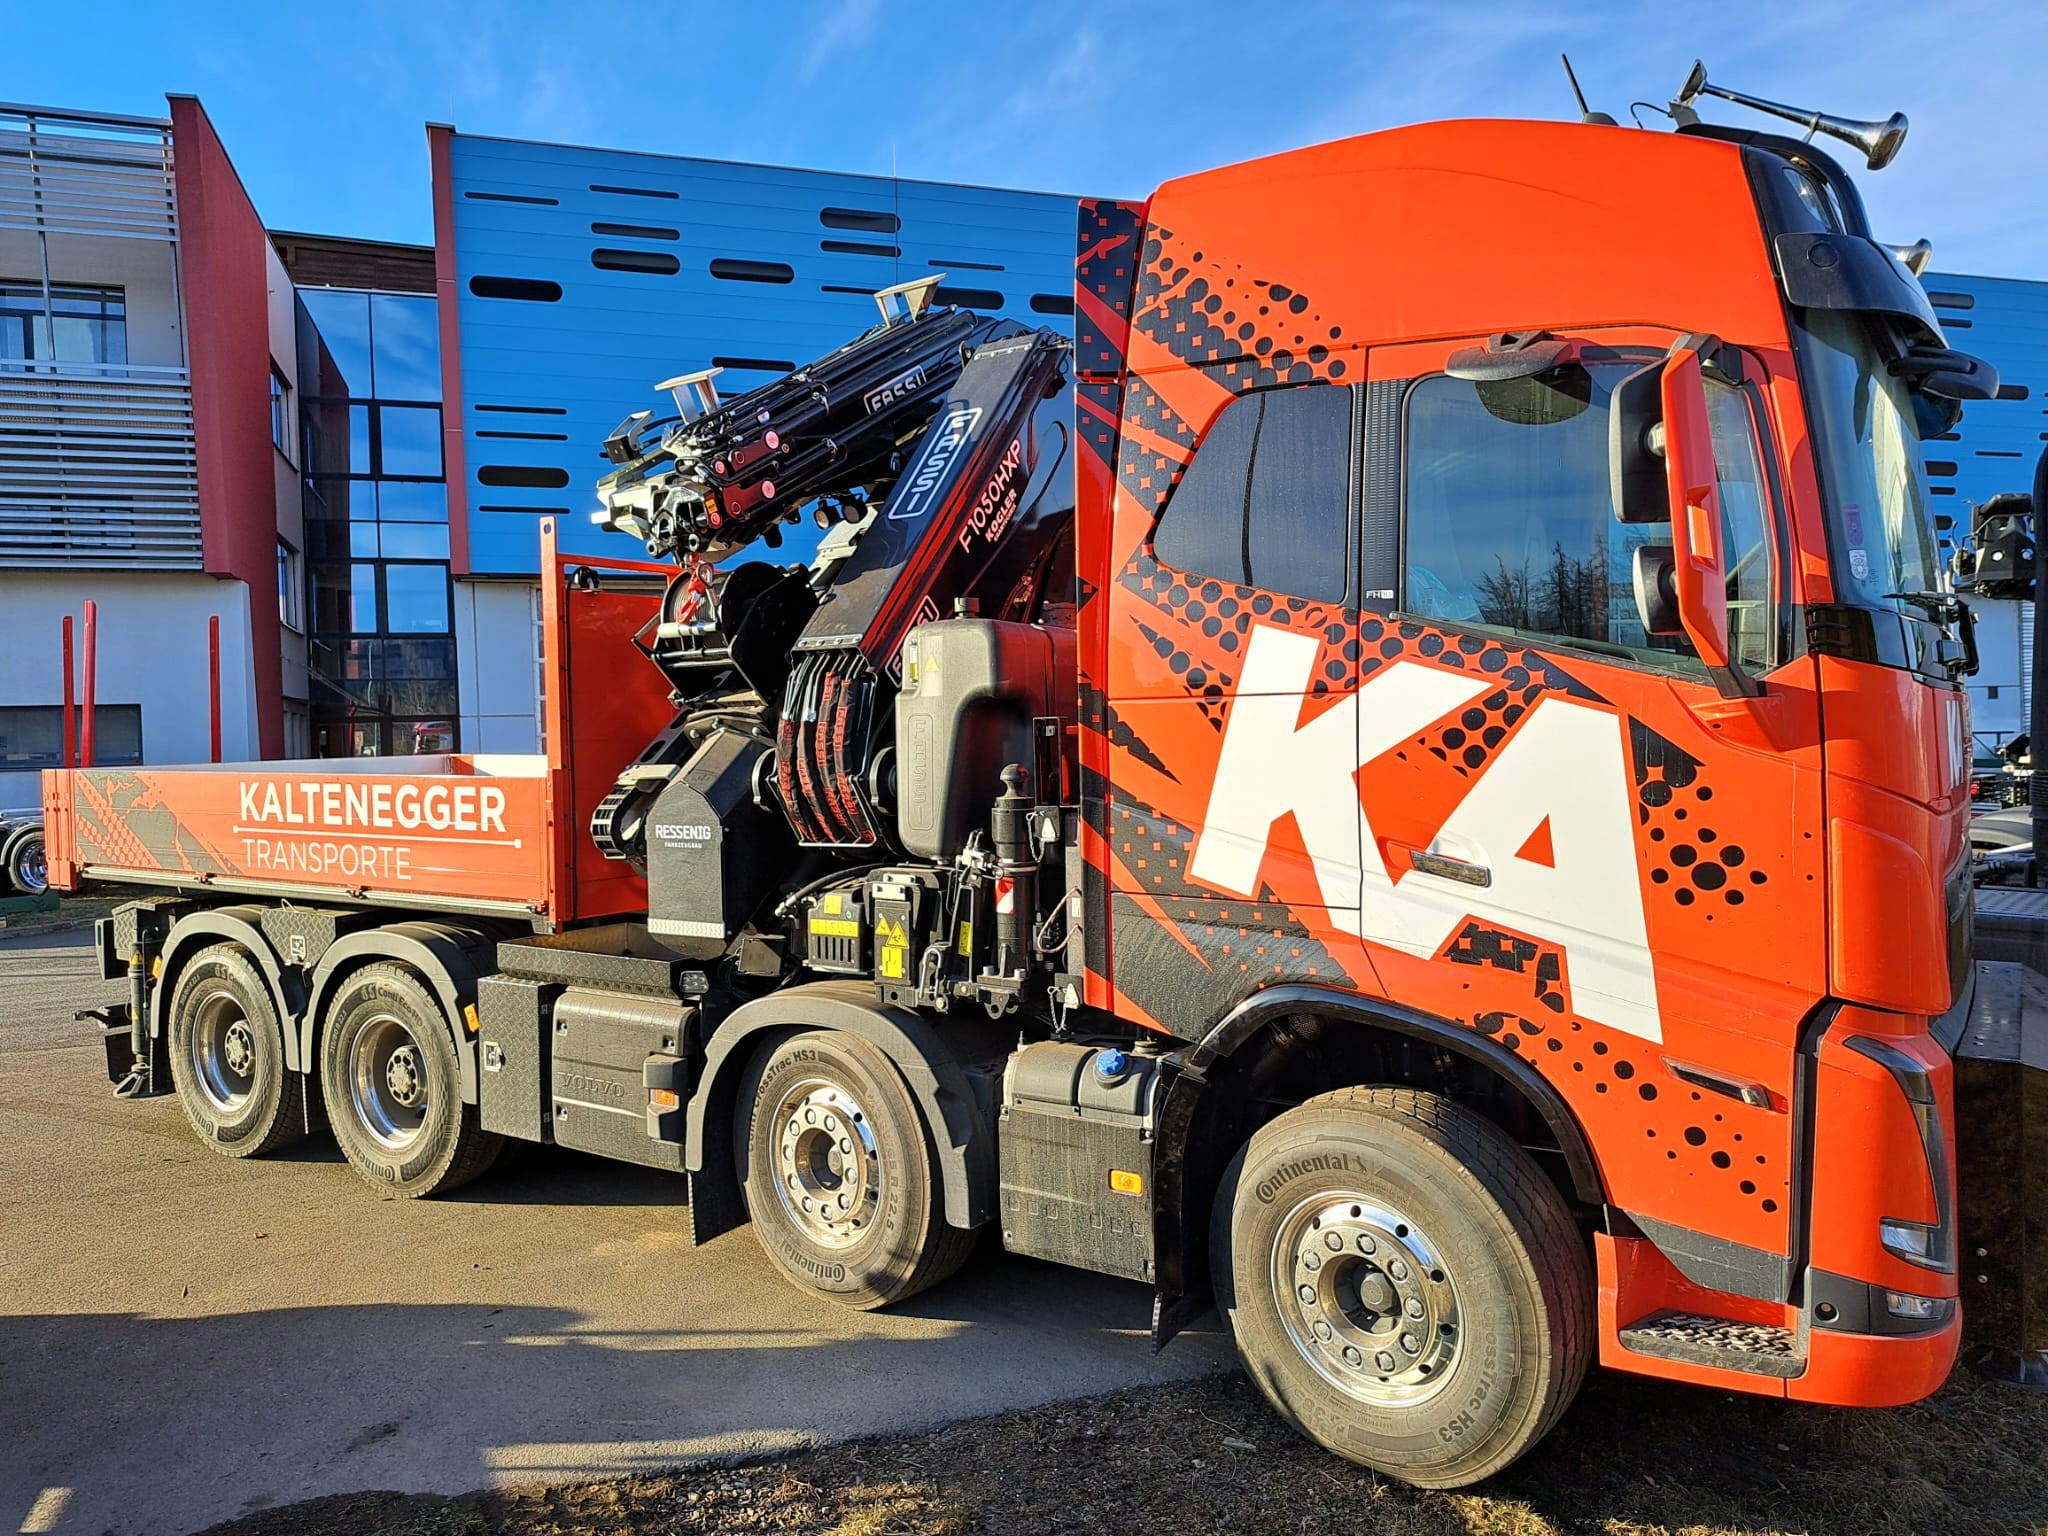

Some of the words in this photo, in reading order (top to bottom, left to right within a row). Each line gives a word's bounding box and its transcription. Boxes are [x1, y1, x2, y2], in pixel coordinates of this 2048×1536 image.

[906, 414, 972, 512] FASSI
[959, 439, 1020, 554] F1050HXP
[985, 488, 1017, 542] KOGLER
[914, 720, 927, 825] FASSI
[239, 781, 507, 833] KALTENEGGER
[655, 824, 712, 840] RESSENIG
[241, 838, 412, 881] TRANSPORTE
[1190, 623, 1664, 1046] KA
[557, 1071, 625, 1097] VOLVO
[754, 1057, 792, 1108] CrossTrac
[793, 1049, 816, 1062] HS3
[1255, 1153, 1349, 1205] Continental
[887, 1191, 899, 1232] 22.5
[780, 1238, 847, 1284] Continental
[1469, 1306, 1498, 1411] CrossTrac
[1438, 1409, 1476, 1443] HS3
